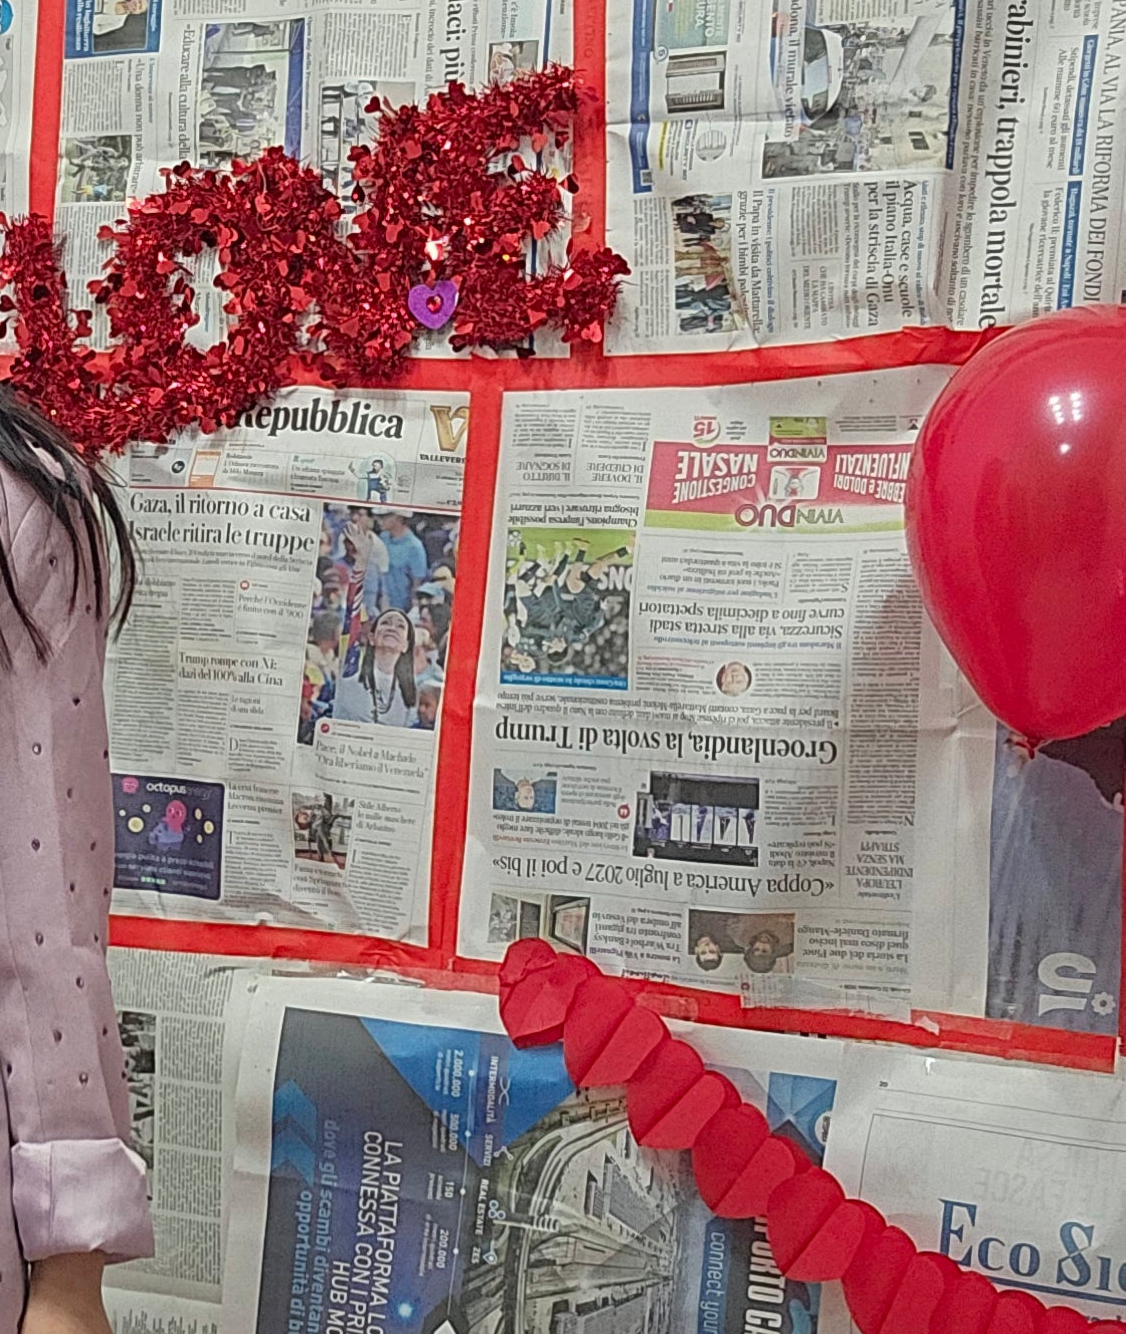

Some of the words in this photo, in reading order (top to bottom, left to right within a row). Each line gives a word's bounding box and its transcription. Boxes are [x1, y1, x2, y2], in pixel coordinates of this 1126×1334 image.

[439, 46, 466, 82] più
[785, 51, 799, 92] murale
[1102, 53, 1121, 74] AL
[1099, 76, 1118, 105] VIA
[1097, 107, 1116, 130] LA
[981, 111, 1019, 223] trappola
[1090, 134, 1114, 216] RIFORMA
[864, 181, 879, 205] per
[886, 181, 900, 189] il
[868, 208, 883, 220] la
[882, 192, 897, 230] piano
[899, 180, 917, 228] Acqua,
[899, 230, 912, 260] case
[1087, 216, 1107, 248] DEI
[866, 223, 882, 273] striscia
[865, 276, 880, 289] di
[881, 235, 897, 303] Italia-Onu
[978, 230, 1017, 329] mortale
[1082, 246, 1107, 304] FONDI
[865, 292, 880, 327] Gaza
[899, 274, 915, 318] scuole
[675, 450, 759, 479] NASALE
[672, 473, 756, 504] CONGESTIONE
[129, 493, 171, 516] Gaza,
[174, 493, 186, 508] il
[189, 494, 249, 516] ritorno
[254, 504, 265, 518] a
[269, 504, 311, 523] casa
[183, 523, 223, 544] ritira
[225, 524, 243, 545] le
[245, 528, 314, 555] truppe
[494, 714, 575, 749] Trump
[578, 726, 598, 750] di
[601, 727, 663, 755] svolta
[661, 731, 683, 756] la
[686, 730, 839, 767] Groenlandia,
[145, 781, 188, 795] octopus
[492, 854, 521, 877] bis»
[525, 858, 536, 878] il
[540, 856, 567, 878] poi
[571, 861, 582, 875] e
[585, 862, 623, 884] 2027
[624, 862, 669, 890] luglio
[673, 871, 682, 886] a
[685, 873, 765, 897] America
[763, 869, 836, 901] «Coppa
[321, 1120, 341, 1158] dove
[384, 1140, 403, 1166] LA
[482, 1134, 493, 1167] SERVIZI
[317, 1164, 338, 1185] gli
[356, 1131, 382, 1236] CONNESSA
[443, 1180, 455, 1199] 150
[480, 1178, 490, 1202] REAL
[315, 1188, 336, 1246] scambi
[474, 1205, 486, 1236] ESTATE
[290, 1190, 313, 1289] opportunità
[370, 1171, 401, 1304] PIATTAFORMA
[437, 1229, 450, 1269] 200.000
[352, 1242, 372, 1284] CON
[706, 1232, 726, 1297] connect
[329, 1260, 351, 1303] HUB
[288, 1293, 306, 1311] di
